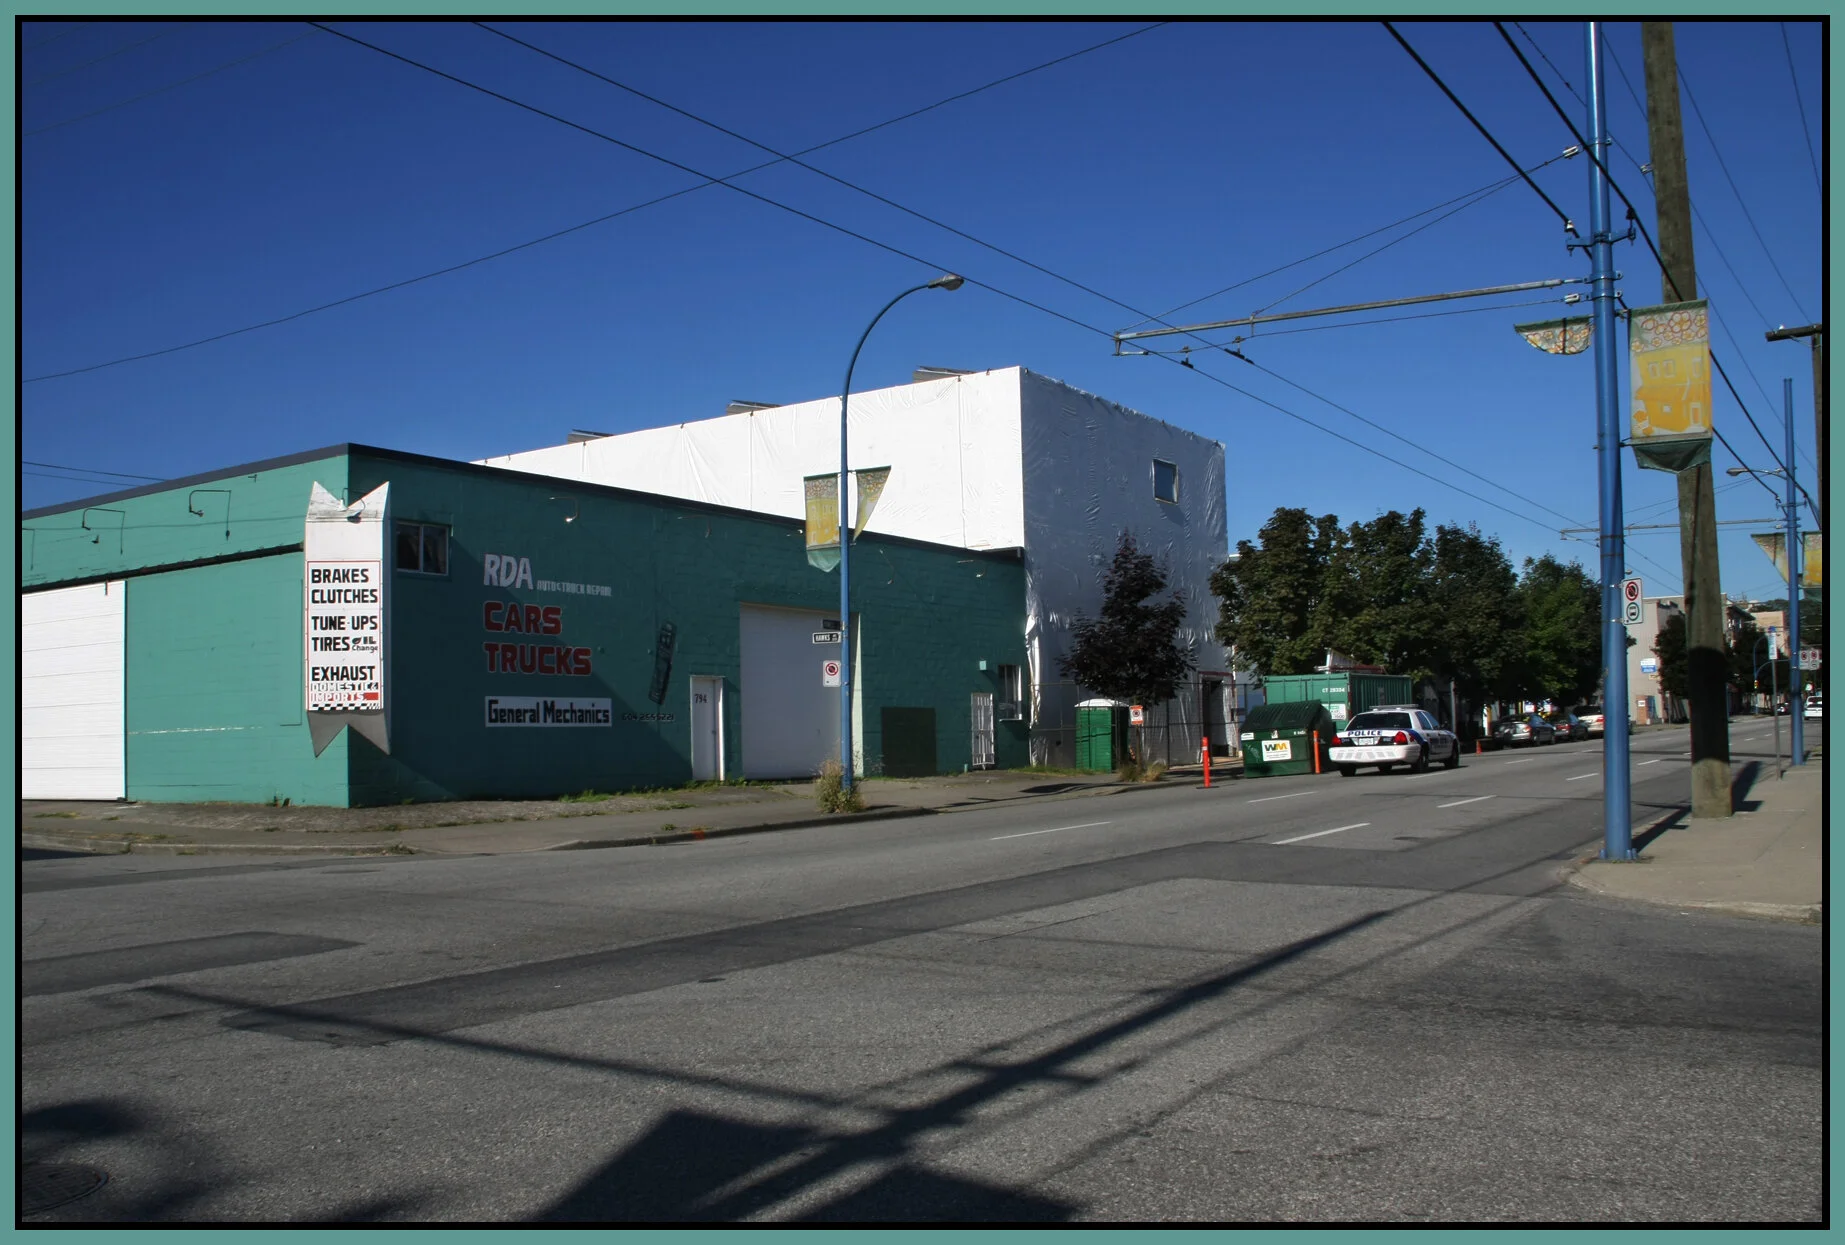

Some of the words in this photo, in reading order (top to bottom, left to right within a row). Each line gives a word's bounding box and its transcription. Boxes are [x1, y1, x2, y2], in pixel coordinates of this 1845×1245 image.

[311, 568, 369, 583] BRAKES
[484, 554, 533, 590] RDA
[311, 589, 378, 604] CLUTCHES
[586, 584, 612, 596] REPAIR
[483, 601, 562, 635] CARS
[311, 636, 350, 652] TIRES
[352, 645, 378, 654] Change
[483, 642, 592, 676] TRUCKS
[311, 665, 376, 681] EXHAUST
[311, 692, 366, 702] IMPORTS
[488, 699, 540, 724] General
[543, 700, 610, 724] Mechanics
[1264, 743, 1288, 751] WM
